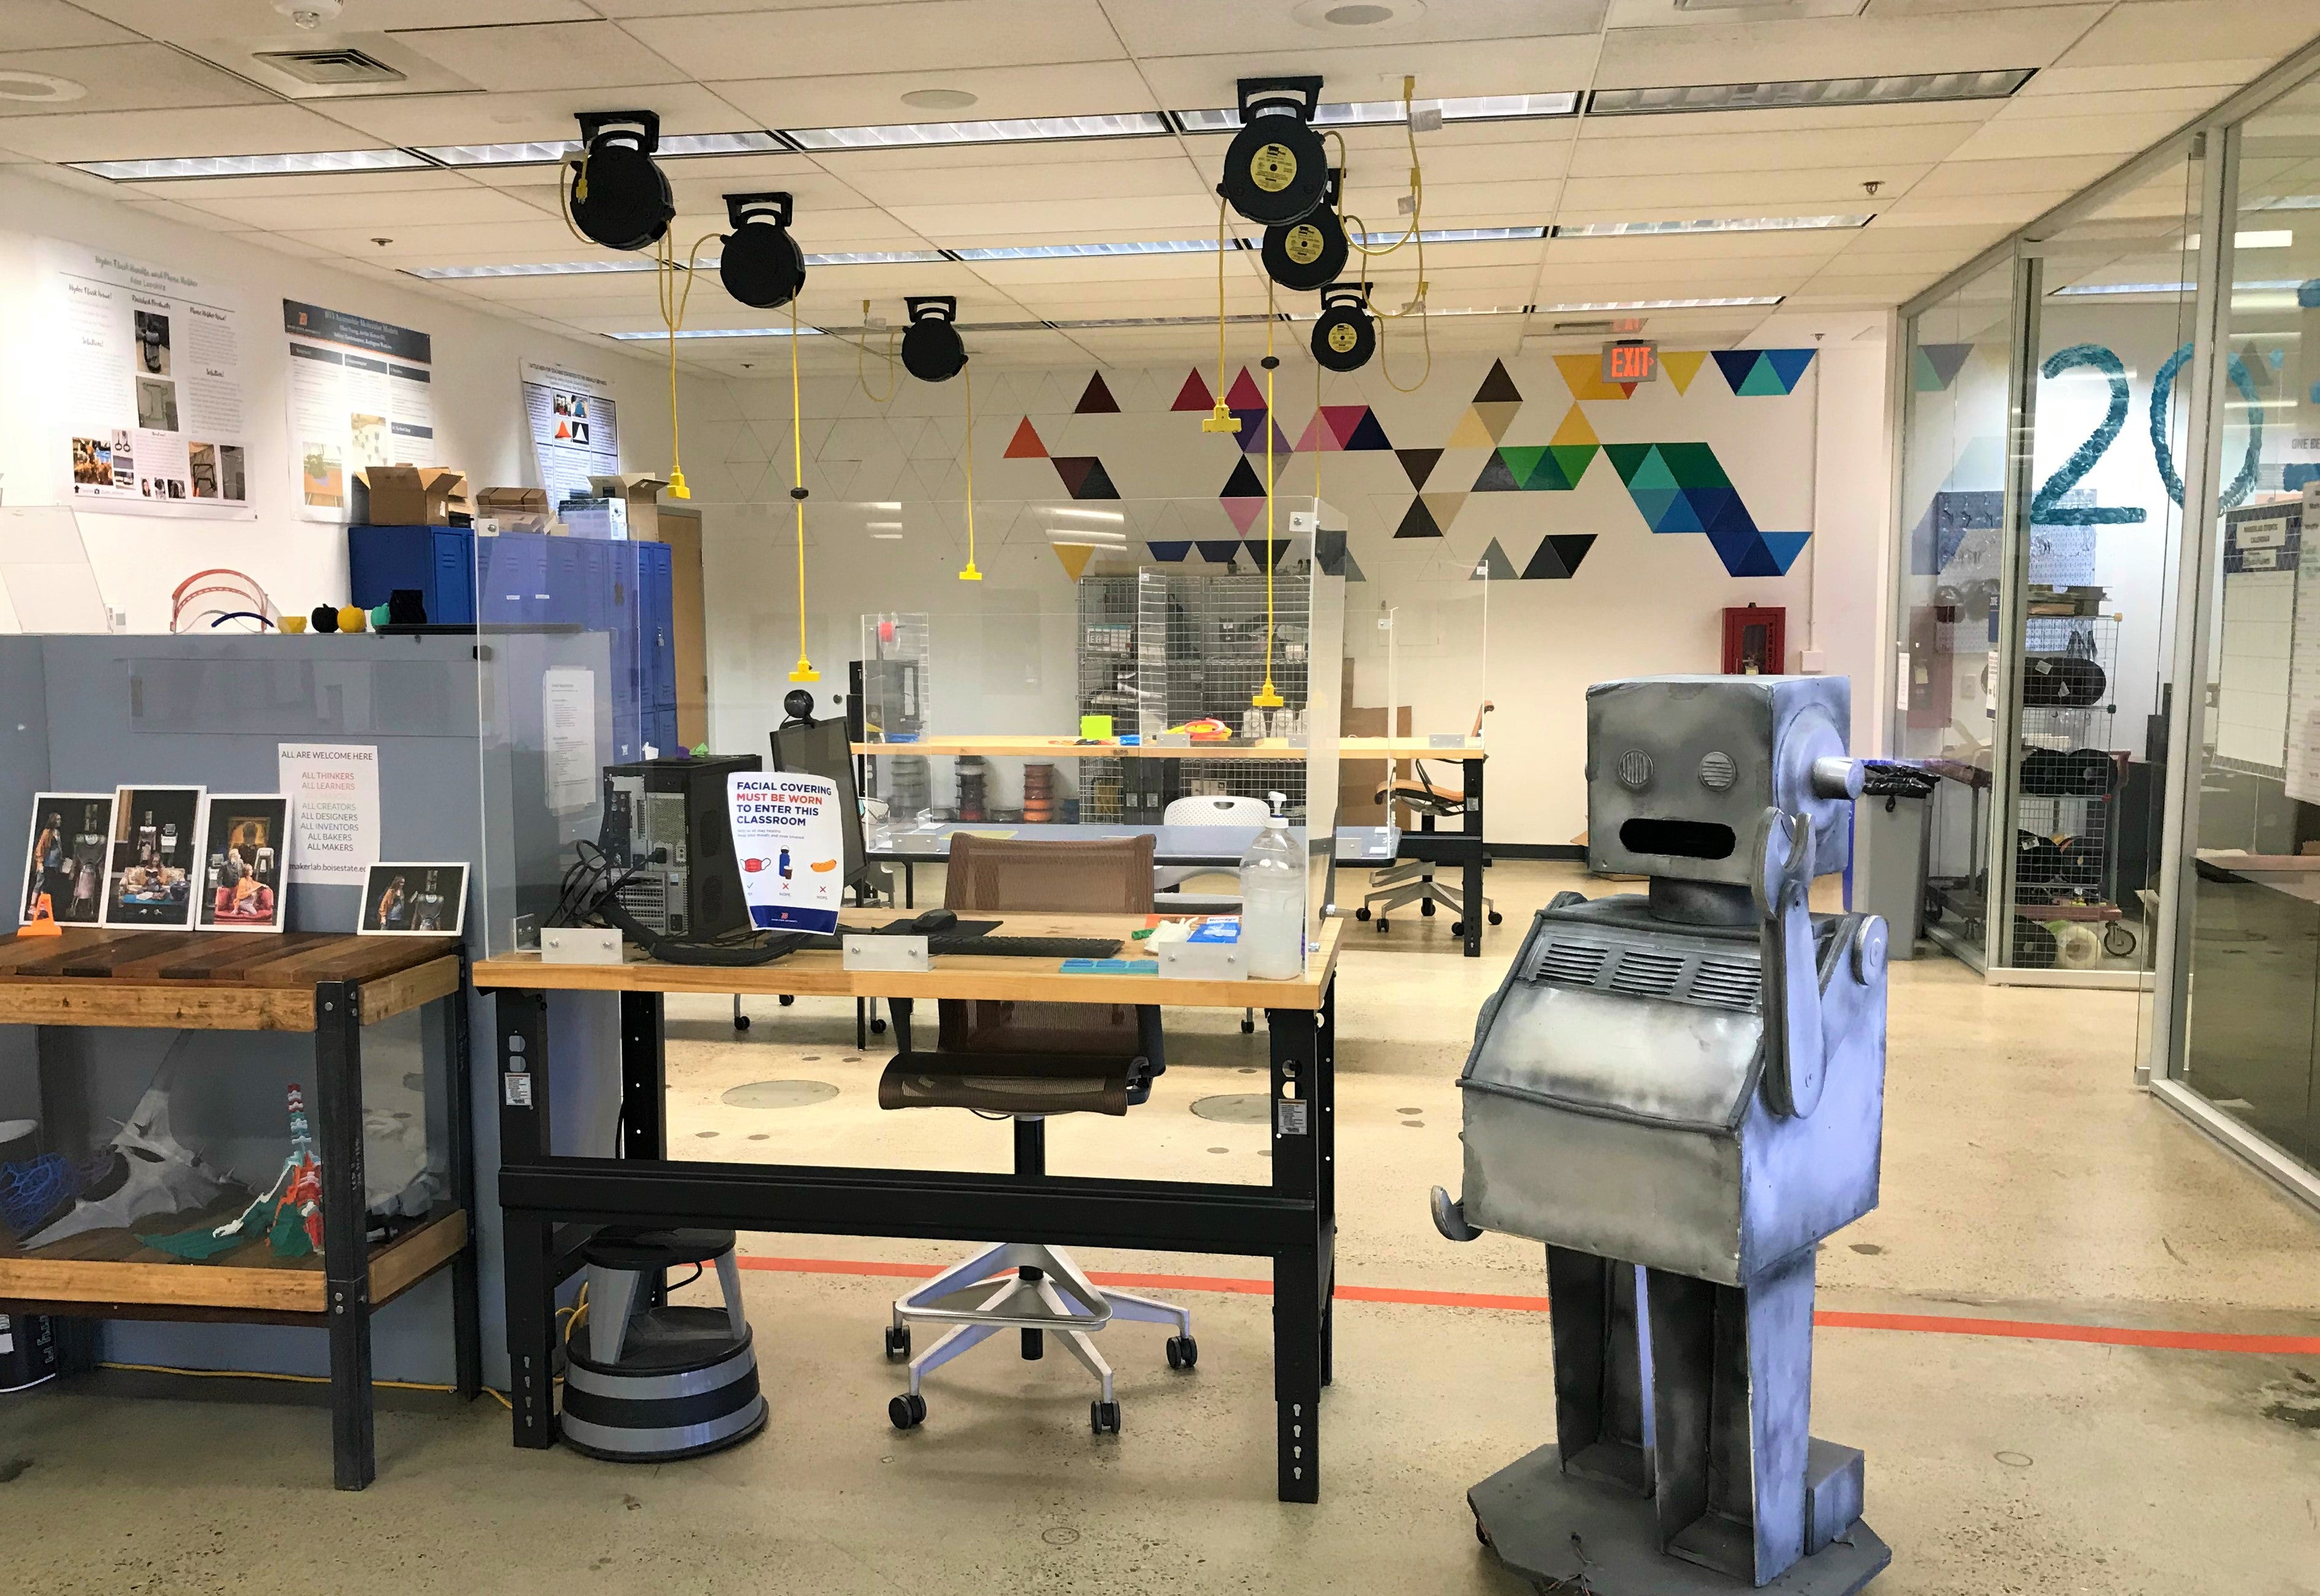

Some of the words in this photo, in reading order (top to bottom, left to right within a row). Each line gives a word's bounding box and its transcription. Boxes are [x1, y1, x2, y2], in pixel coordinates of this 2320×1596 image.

[1611, 347, 1651, 377] EXIT
[737, 782, 777, 791] FACIAL
[780, 783, 832, 796] COVERING
[736, 793, 768, 802] MUST
[788, 794, 823, 805] WORN
[755, 805, 792, 814] ENTER
[795, 806, 819, 816] THIS
[736, 816, 806, 826] CLASSROOM
